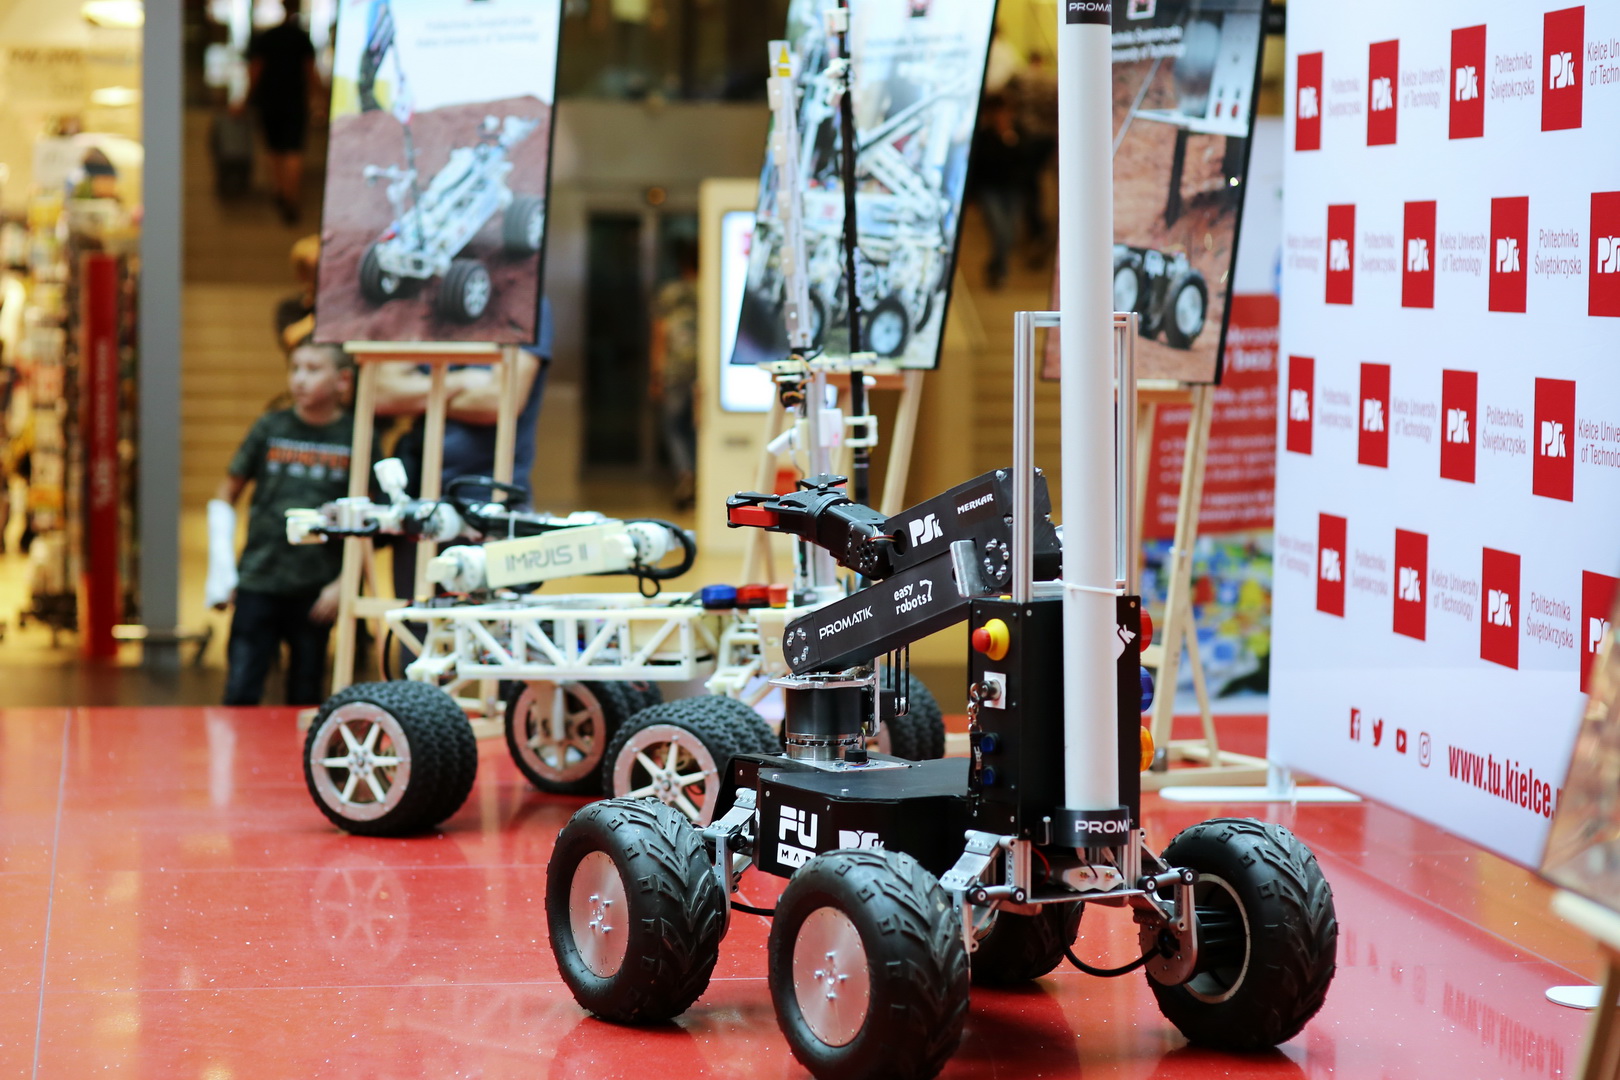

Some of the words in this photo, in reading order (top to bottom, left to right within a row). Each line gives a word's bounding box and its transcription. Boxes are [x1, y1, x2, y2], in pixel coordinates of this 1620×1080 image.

[1495, 51, 1532, 73] Politechnika
[1587, 40, 1608, 62] Kielce
[1590, 65, 1597, 86] of
[1539, 227, 1579, 249] Politechnika
[1534, 250, 1582, 279] Świętokrzyska
[1486, 405, 1524, 429] Politechnika
[1578, 418, 1599, 440] Kielce
[1581, 443, 1588, 463] of
[957, 493, 994, 515] MERKAR
[894, 583, 914, 601] easy
[895, 594, 927, 615] robots
[1531, 591, 1571, 622] Politechnika
[819, 605, 874, 640] PROMATIK
[1526, 611, 1574, 649] Świętokrzyska
